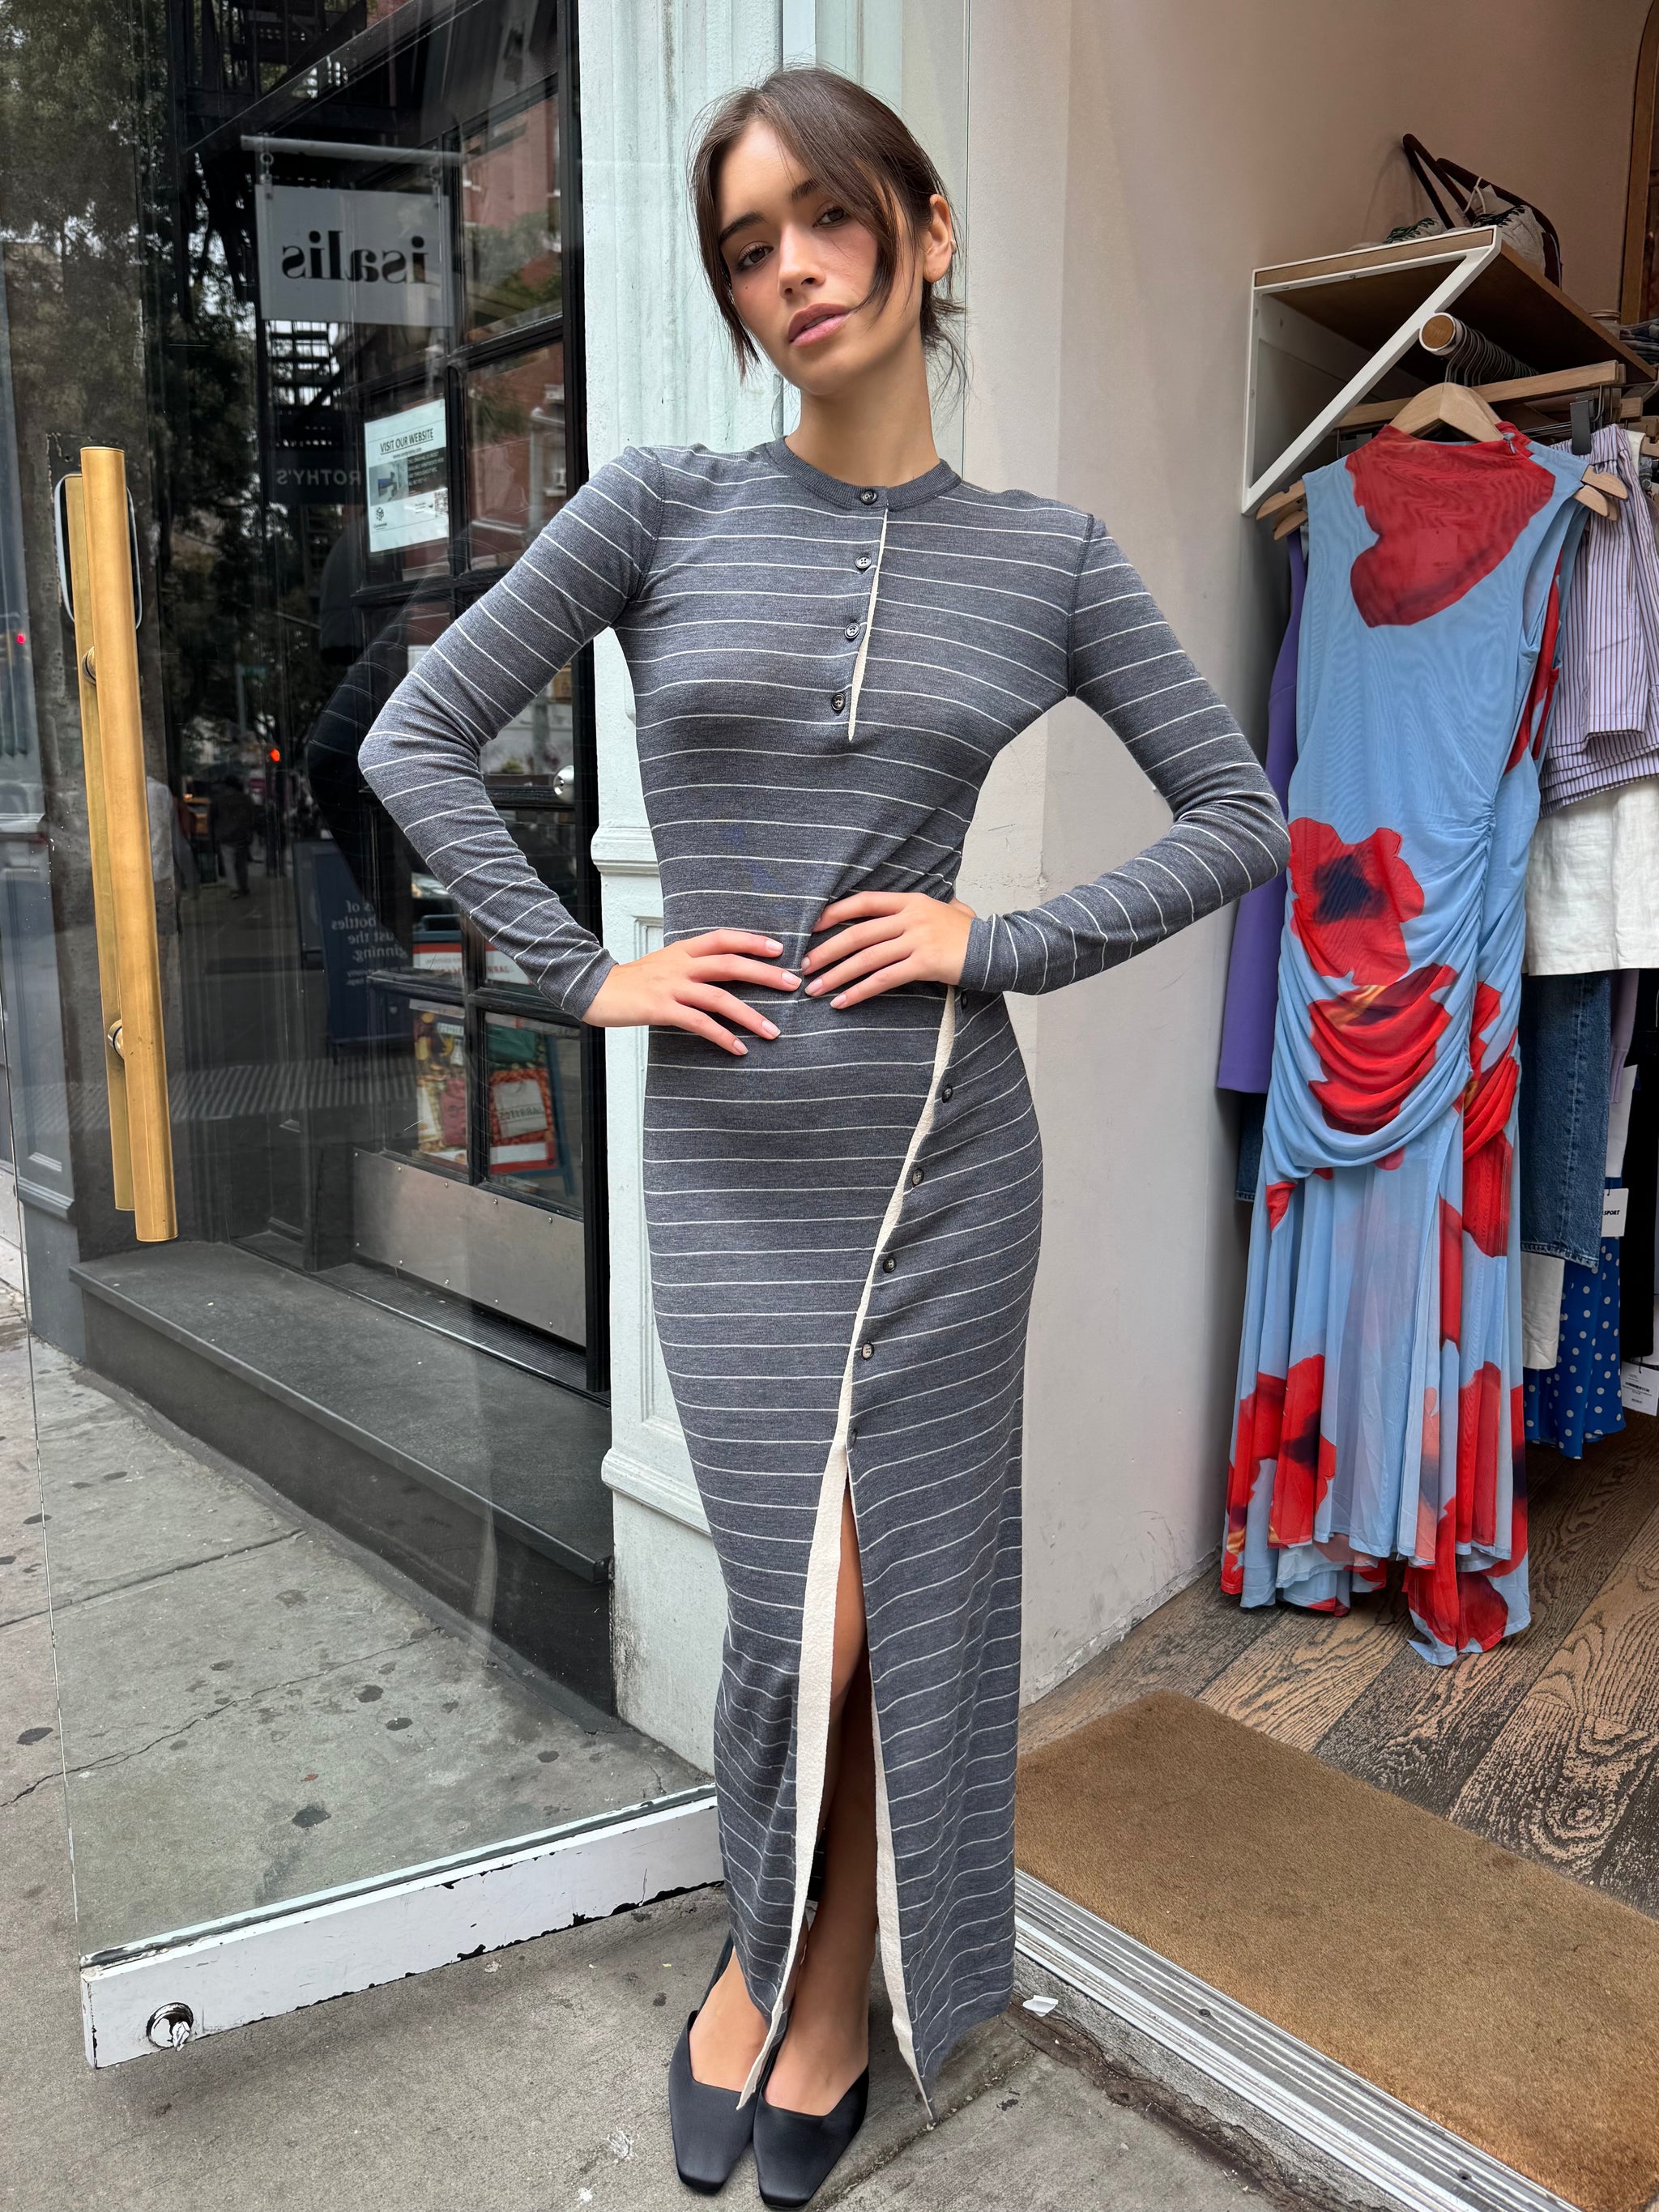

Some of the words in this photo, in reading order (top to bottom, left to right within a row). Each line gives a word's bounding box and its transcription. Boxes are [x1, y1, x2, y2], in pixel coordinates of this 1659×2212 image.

[380, 440, 394, 453] VISIT
[395, 437, 407, 448] OUR
[409, 428, 433, 442] WEBSITE
